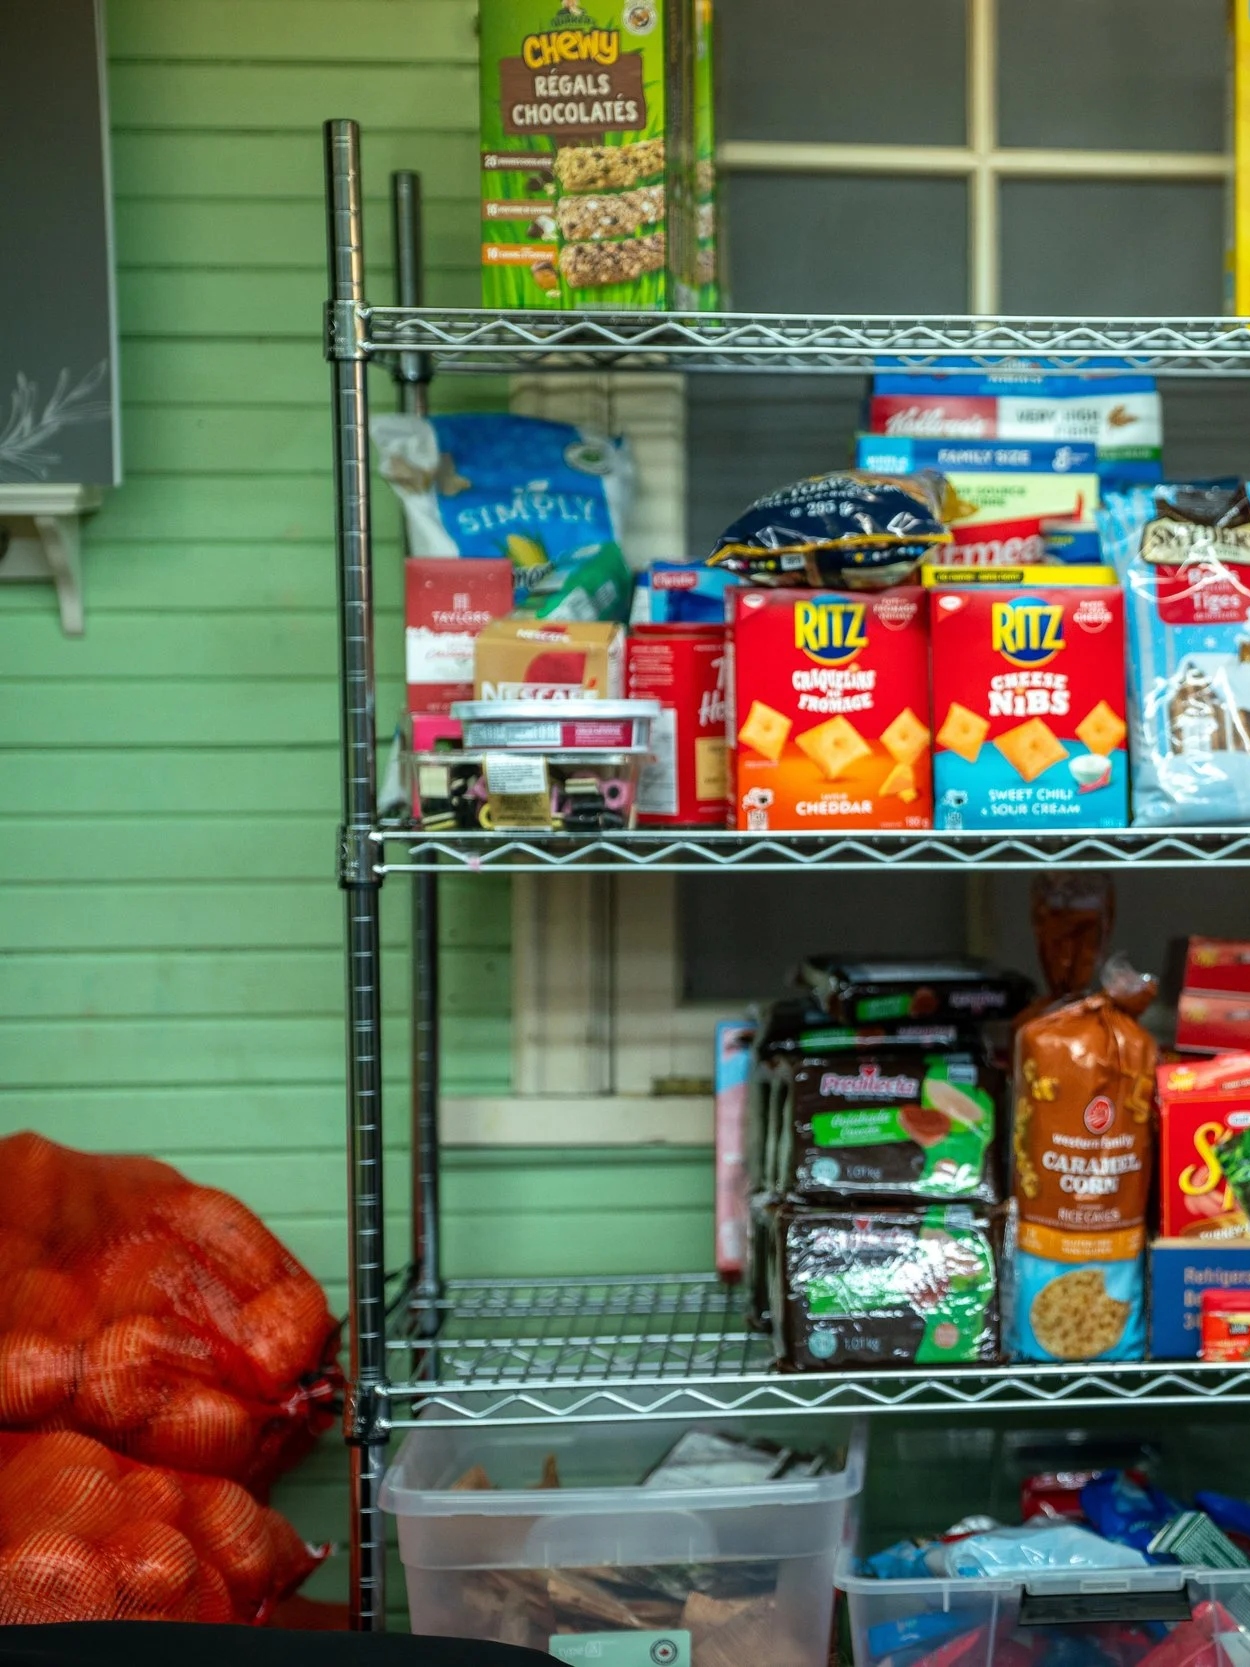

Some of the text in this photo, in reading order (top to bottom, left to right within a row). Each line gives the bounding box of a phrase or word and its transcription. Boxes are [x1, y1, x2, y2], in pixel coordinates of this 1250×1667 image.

[534, 69, 611, 97] RÉGALS
[512, 94, 639, 126] CHOCOLATÉS
[457, 492, 595, 536] SIMPLY
[794, 600, 870, 652] RITZ
[991, 602, 1067, 654] RITZ
[795, 800, 873, 816] CHEDDAR
[988, 788, 1033, 802] SWEET
[990, 803, 1028, 816] SOUR
[1031, 803, 1081, 816] CREAM
[1041, 1150, 1142, 1177] CARAMEL
[1059, 1173, 1120, 1195] CORN
